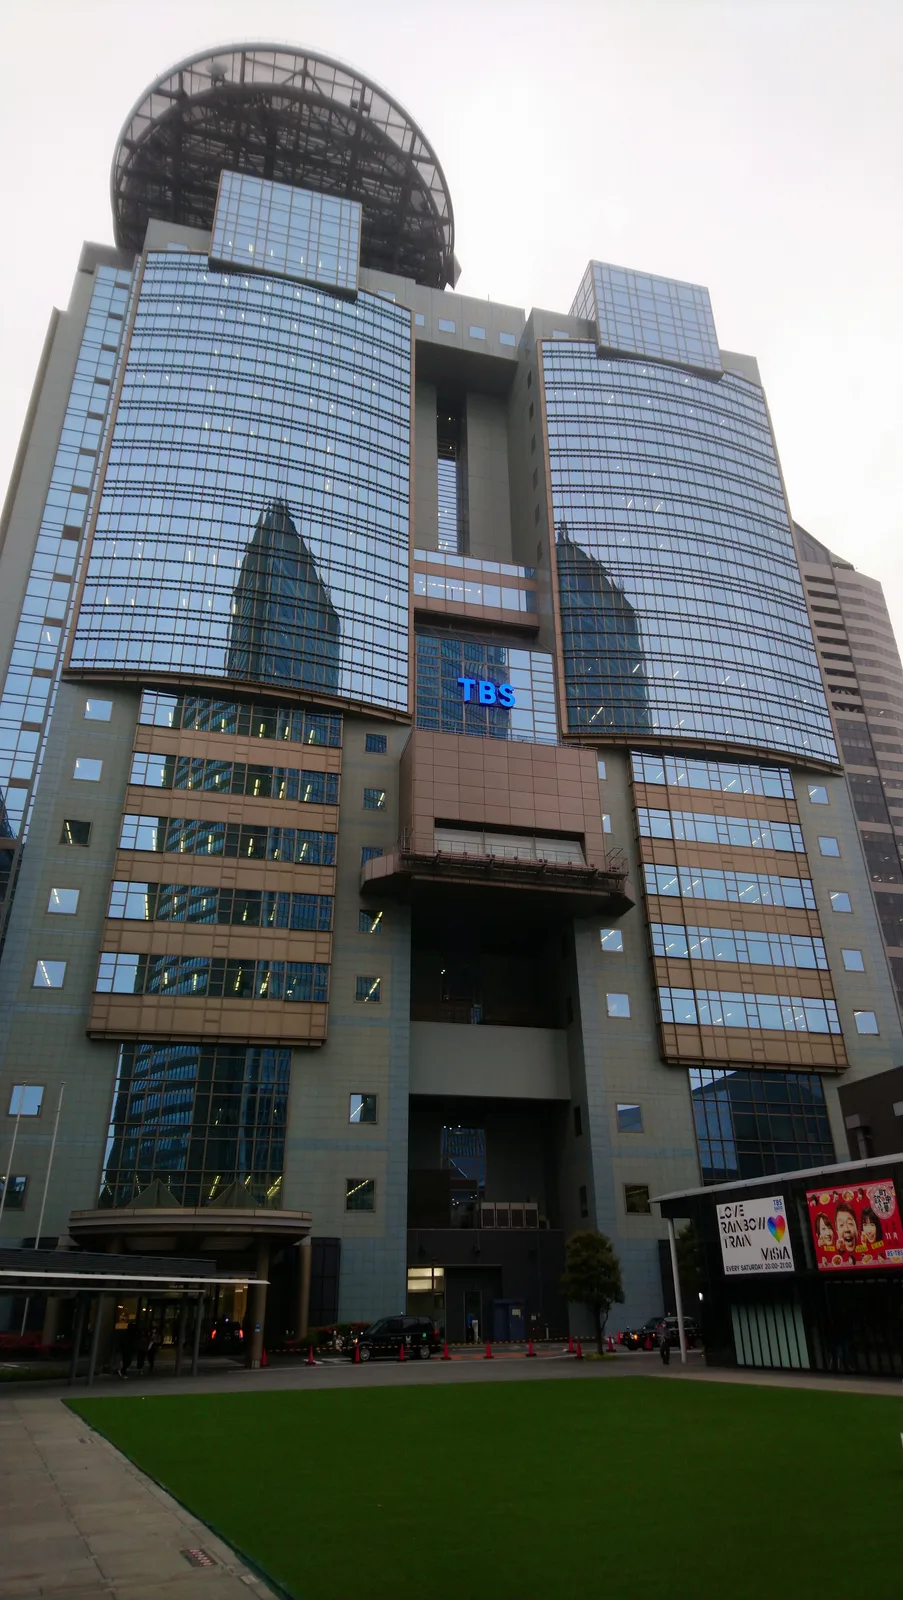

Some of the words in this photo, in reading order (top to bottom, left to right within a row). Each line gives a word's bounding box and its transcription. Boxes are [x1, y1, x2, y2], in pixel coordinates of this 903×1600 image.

[457, 677, 516, 708] TBS
[720, 1204, 744, 1219] LOVE
[720, 1217, 766, 1234] RAINBOW
[722, 1234, 752, 1249] TRAIN
[761, 1246, 791, 1261] VISIA
[740, 1263, 764, 1272] SATURDAY
